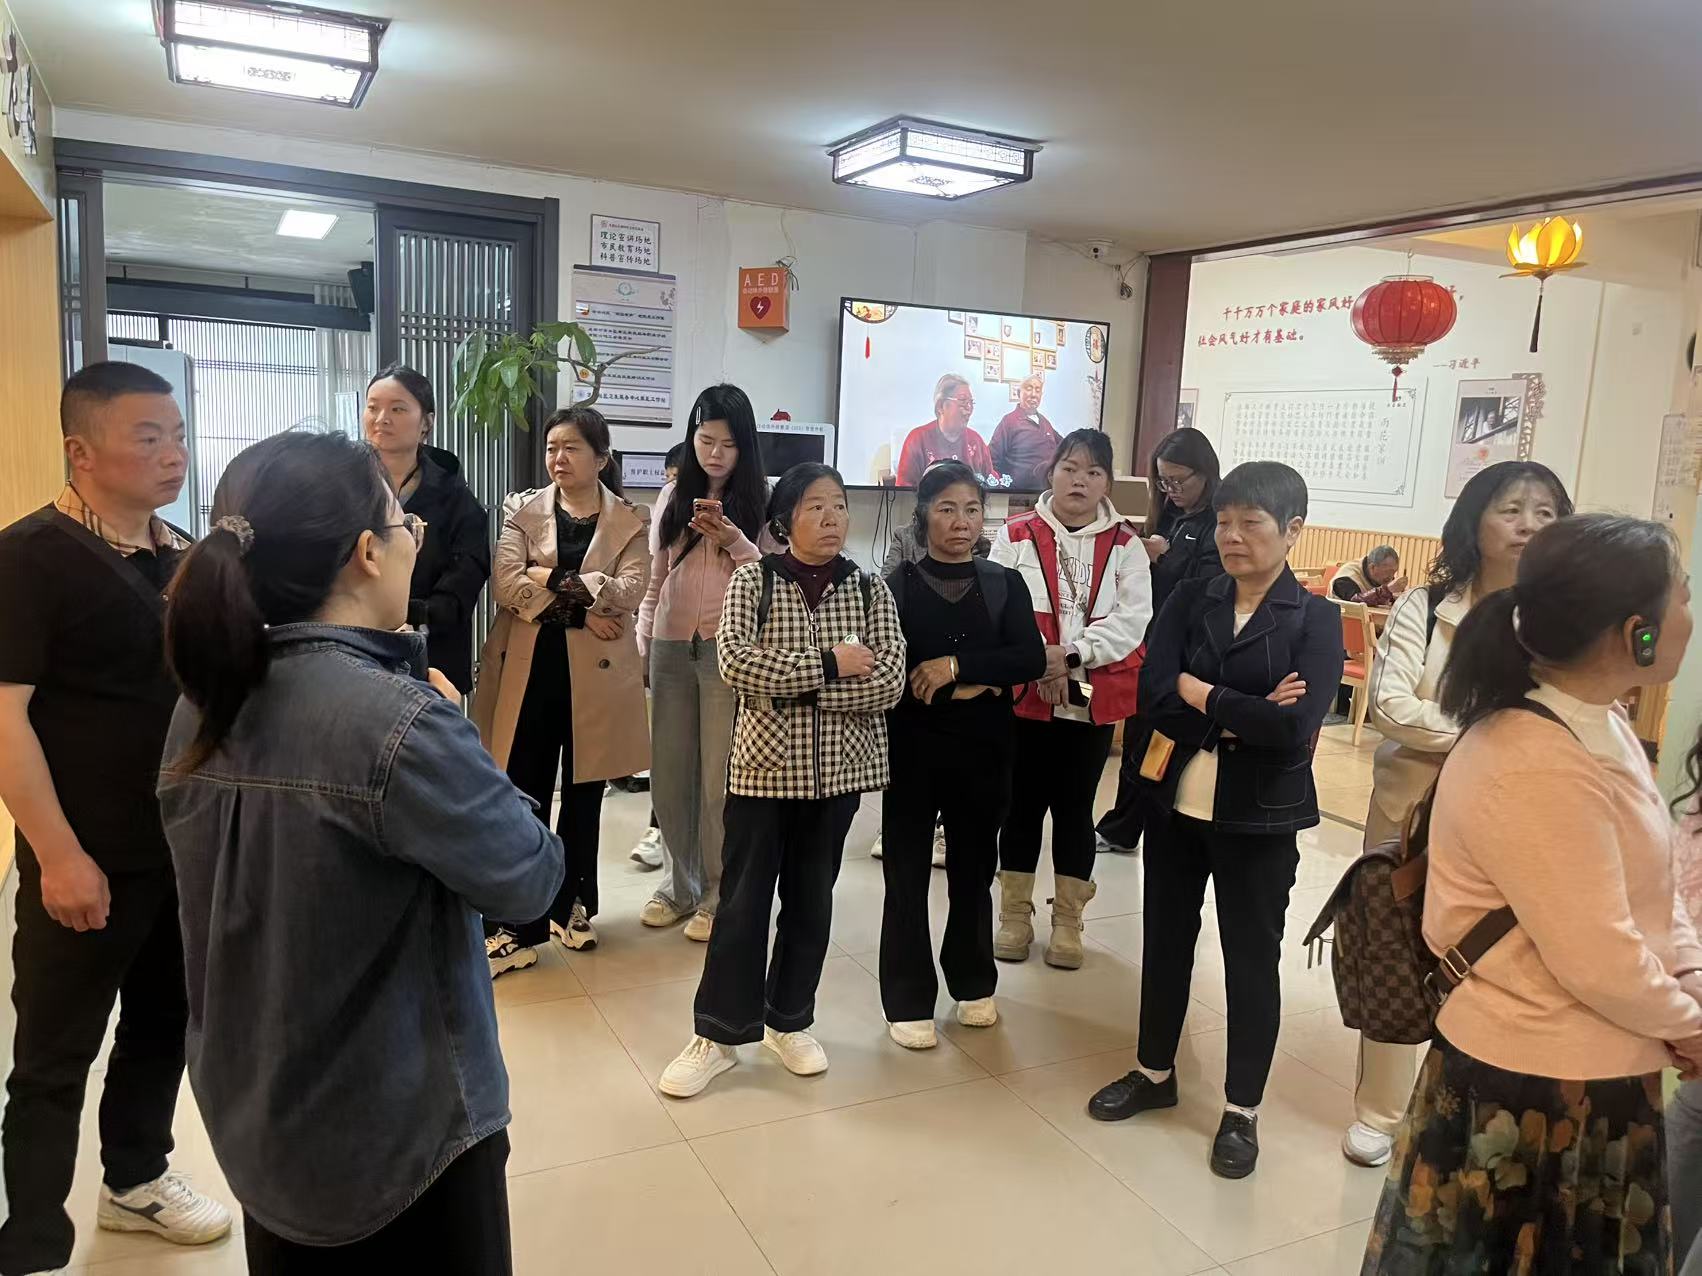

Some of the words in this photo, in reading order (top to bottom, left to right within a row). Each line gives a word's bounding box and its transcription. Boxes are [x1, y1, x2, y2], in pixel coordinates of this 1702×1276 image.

[600, 231, 652, 245] 理论宣讲场地
[600, 241, 652, 255] 市民教育场地
[600, 252, 652, 266] 科普宣传场地
[743, 272, 779, 287] AED
